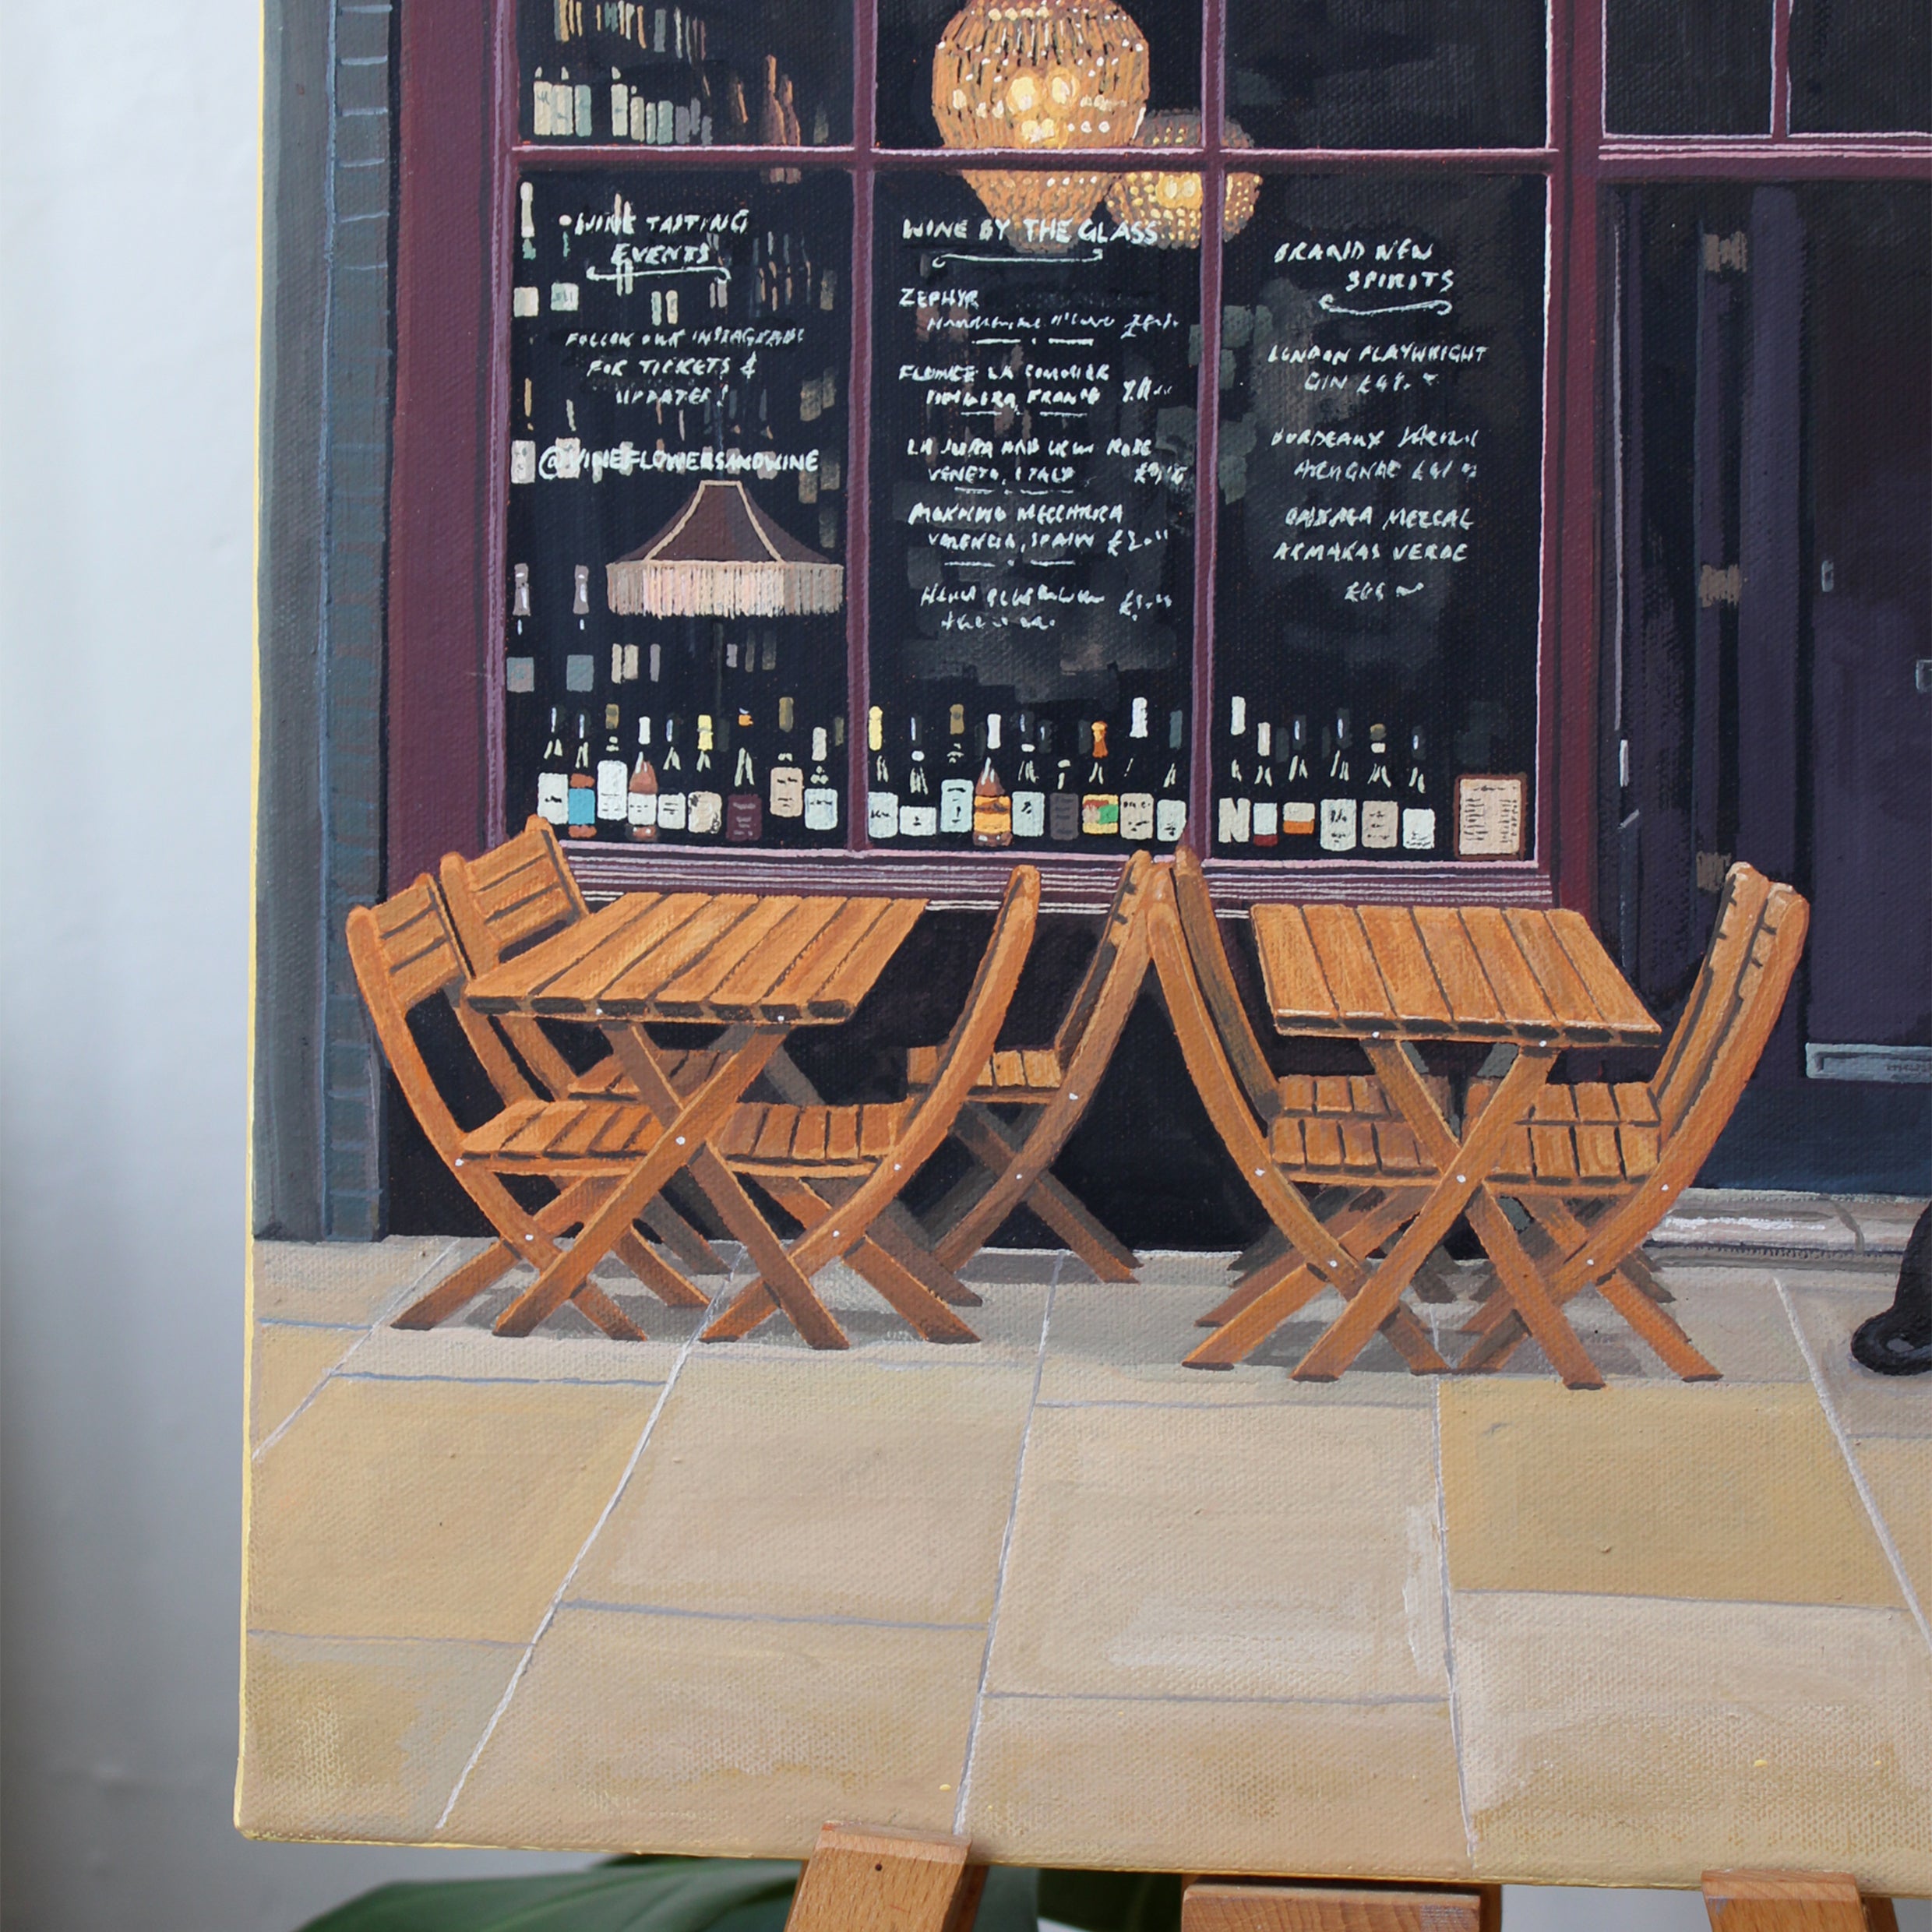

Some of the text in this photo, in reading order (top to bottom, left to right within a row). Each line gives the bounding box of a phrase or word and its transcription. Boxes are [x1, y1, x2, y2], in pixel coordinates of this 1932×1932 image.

[646, 209, 749, 234] TASTING
[902, 217, 1158, 246] WINE BY THE GLASS
[610, 242, 710, 266] EVENTS
[1274, 238, 1433, 263] BRAND NEW
[1345, 269, 1454, 292] SPIRITS
[898, 287, 979, 310] ZEPHYR
[638, 357, 731, 377] TICKETS
[1304, 371, 1348, 391] GIN
